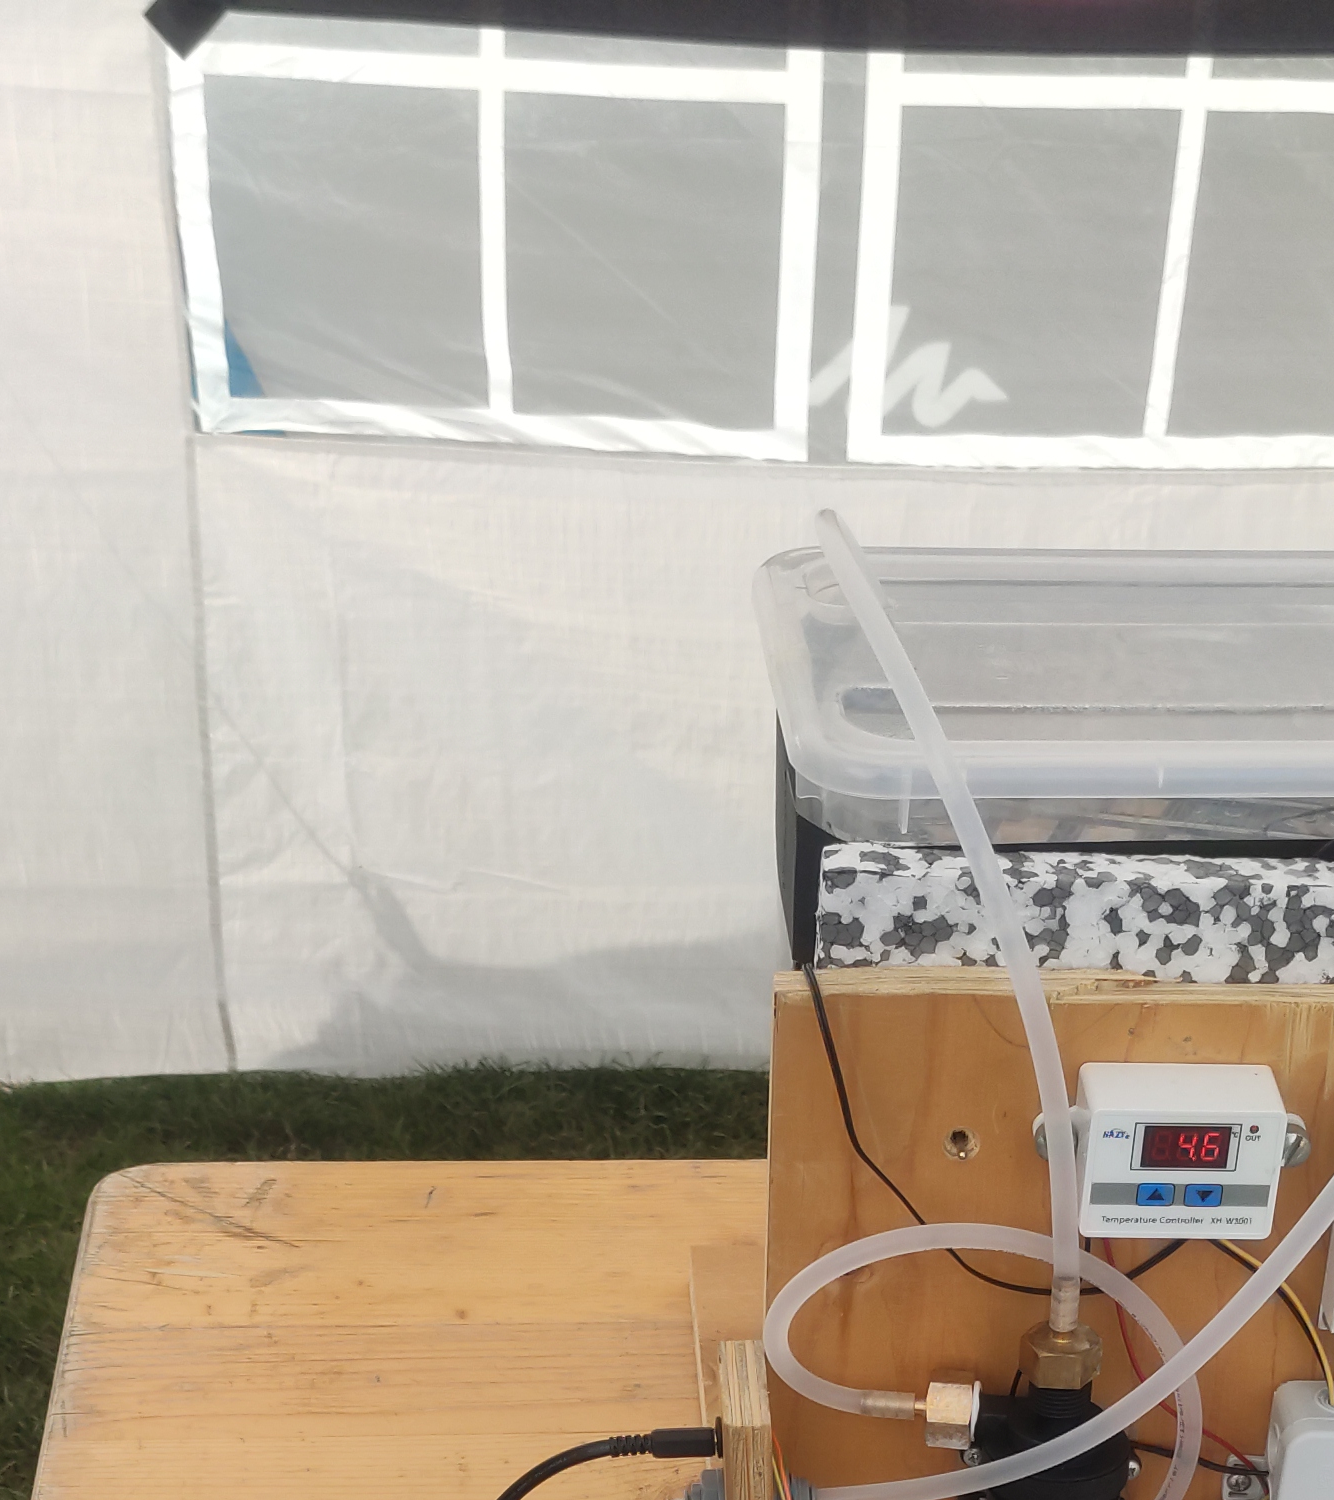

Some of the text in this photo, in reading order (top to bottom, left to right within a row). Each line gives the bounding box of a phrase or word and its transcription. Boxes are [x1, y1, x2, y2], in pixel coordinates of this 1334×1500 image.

[1245, 1134, 1262, 1142] OUT
[1101, 1215, 1158, 1226] Temperature
[1159, 1216, 1204, 1225] Controller
